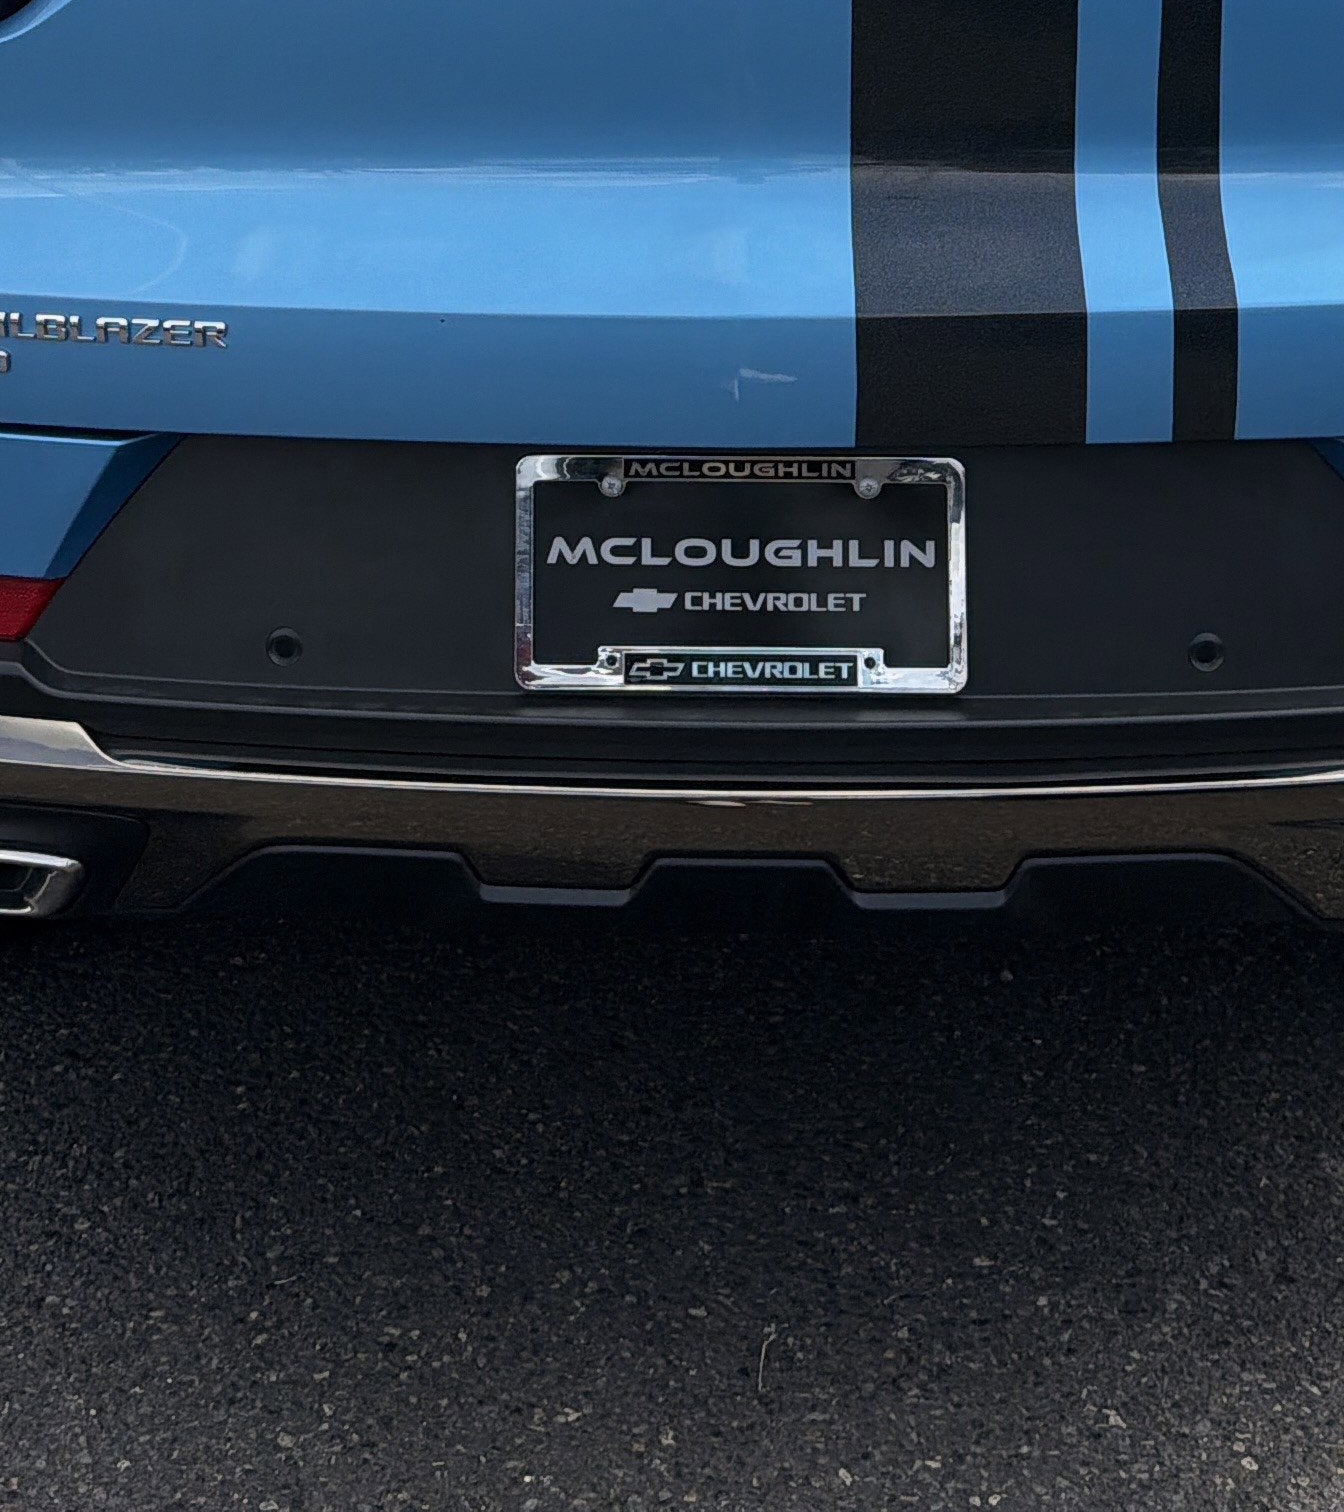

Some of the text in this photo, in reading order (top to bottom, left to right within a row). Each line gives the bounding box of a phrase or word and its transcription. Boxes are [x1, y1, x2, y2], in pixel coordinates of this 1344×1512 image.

[627, 461, 853, 478] MCLOUGHLIN
[546, 536, 937, 569] MCLOUGHLIN
[683, 591, 868, 613] CHEVROLET
[690, 659, 855, 680] CHEVROLET
